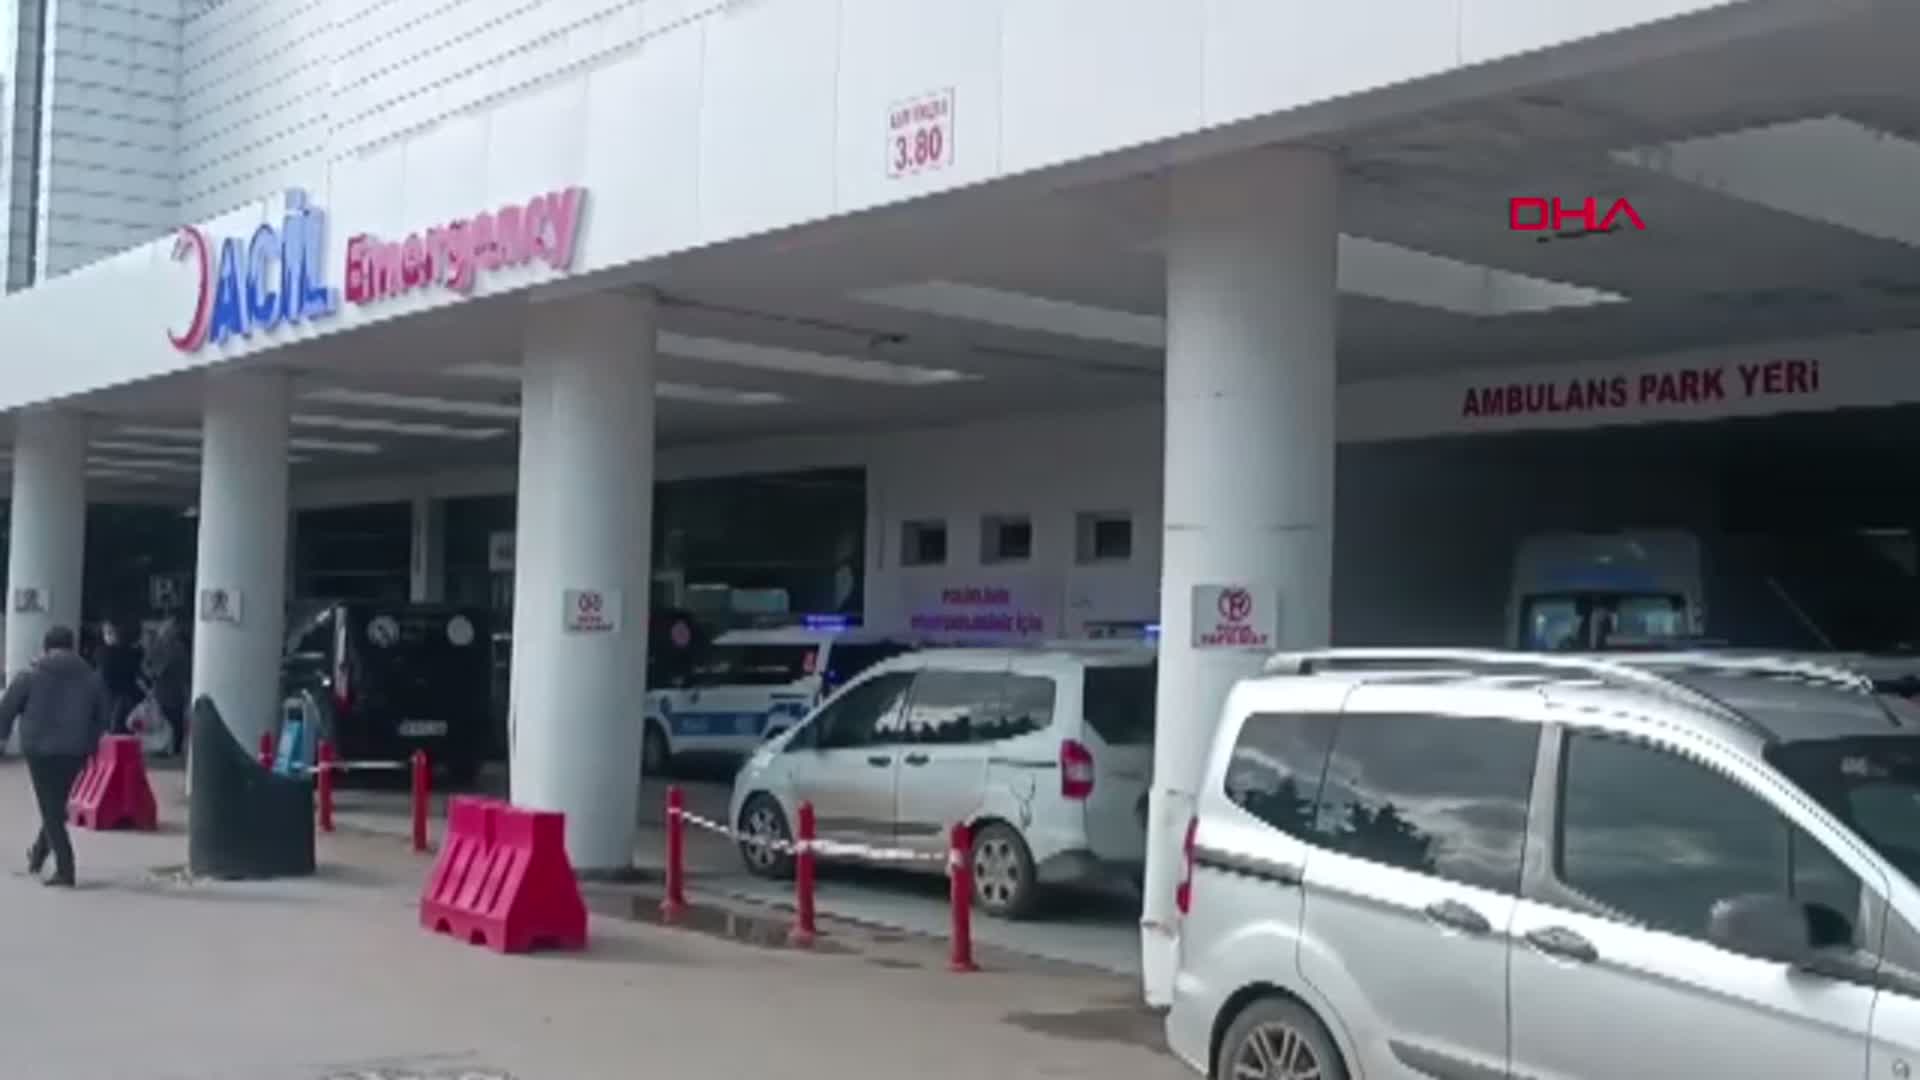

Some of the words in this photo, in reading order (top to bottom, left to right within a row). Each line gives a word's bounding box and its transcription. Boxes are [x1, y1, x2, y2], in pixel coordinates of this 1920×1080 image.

[895, 125, 942, 170] 3.80
[208, 187, 338, 344] ACİL
[345, 187, 589, 305] Emergency
[1462, 376, 1627, 416] AMBULANS
[1639, 367, 1726, 405] PARK
